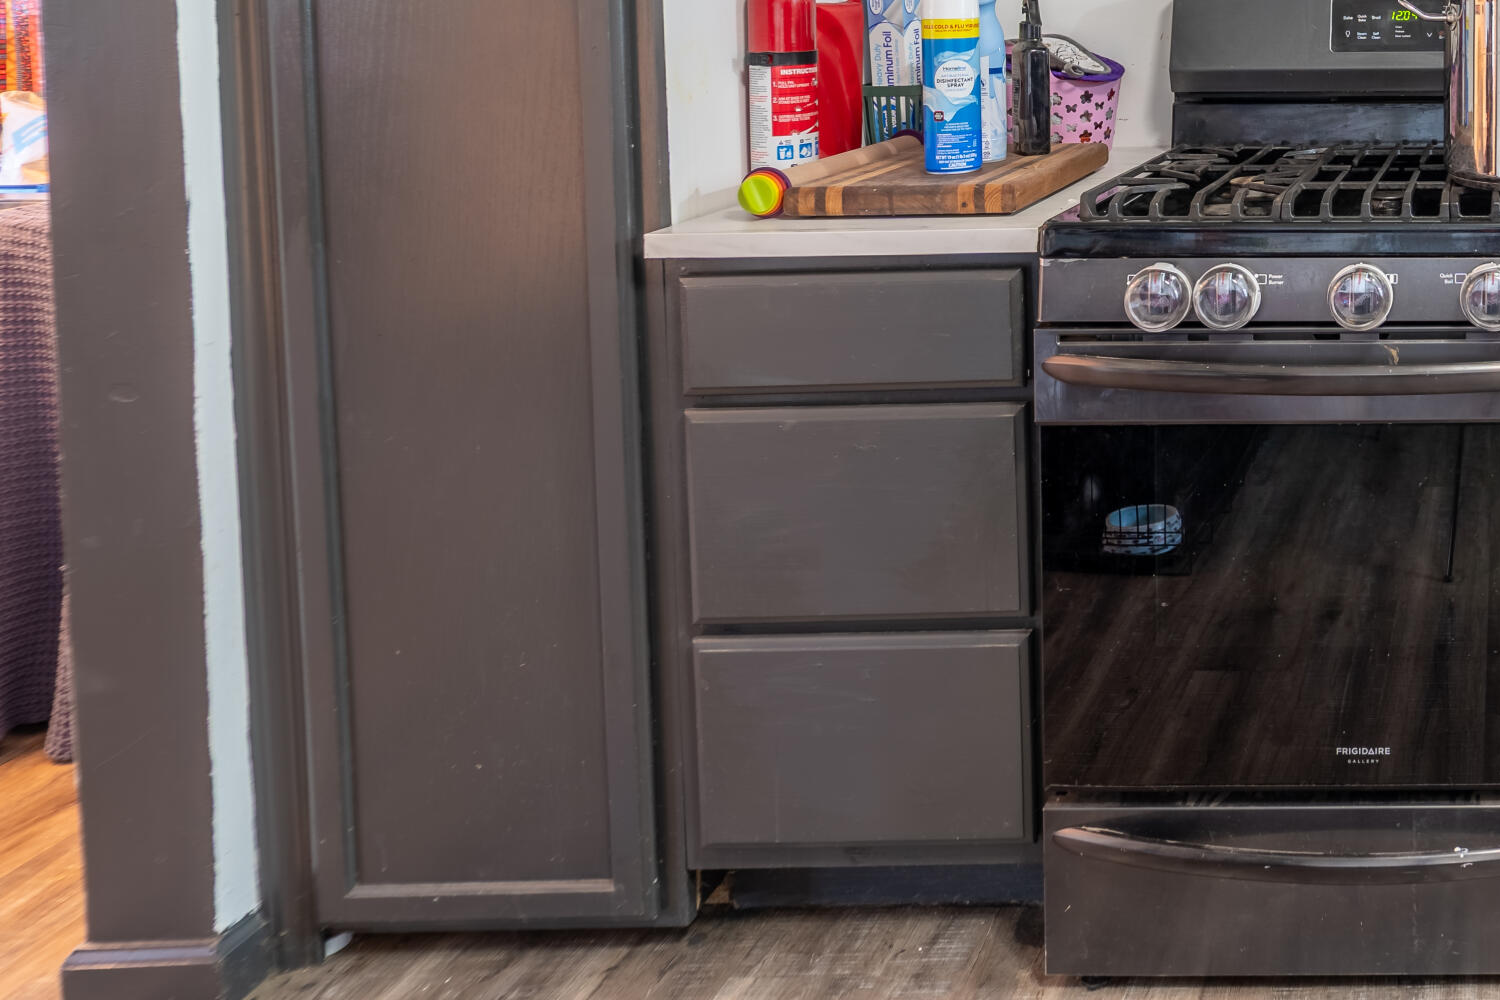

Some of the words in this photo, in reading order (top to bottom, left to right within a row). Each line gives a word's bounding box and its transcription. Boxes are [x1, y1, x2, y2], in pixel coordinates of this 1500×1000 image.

[882, 31, 892, 48] Foil
[936, 77, 974, 85] DISINFECTANT
[1336, 747, 1391, 756] FRIGIDAIRE
